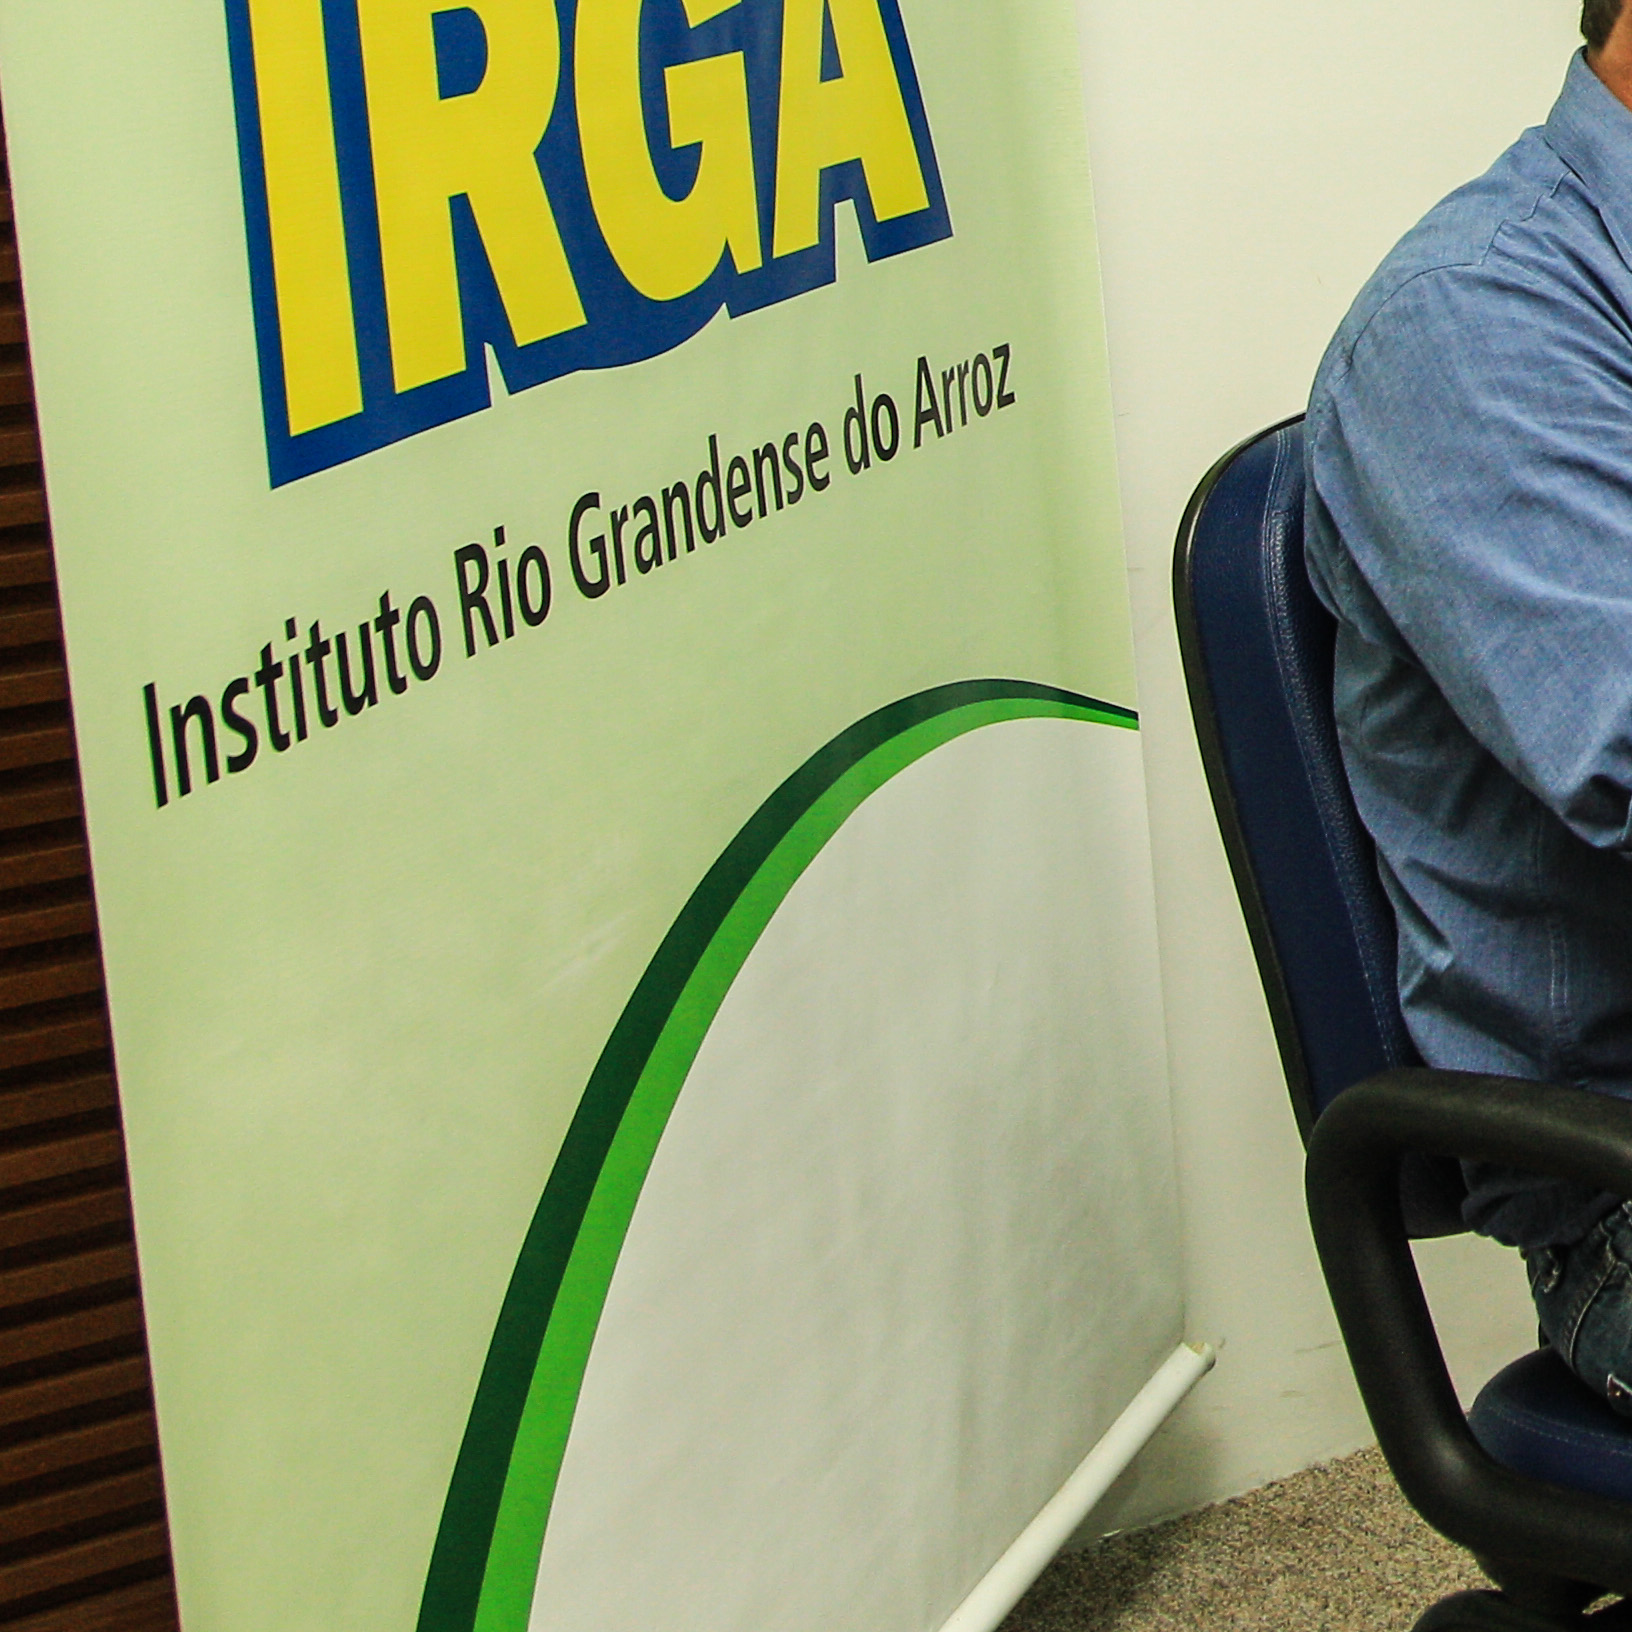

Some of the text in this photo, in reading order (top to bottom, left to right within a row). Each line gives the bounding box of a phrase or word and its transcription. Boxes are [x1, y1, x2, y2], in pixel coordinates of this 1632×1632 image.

[142, 341, 1016, 808] Instituto Rio Grandense do Arroz
